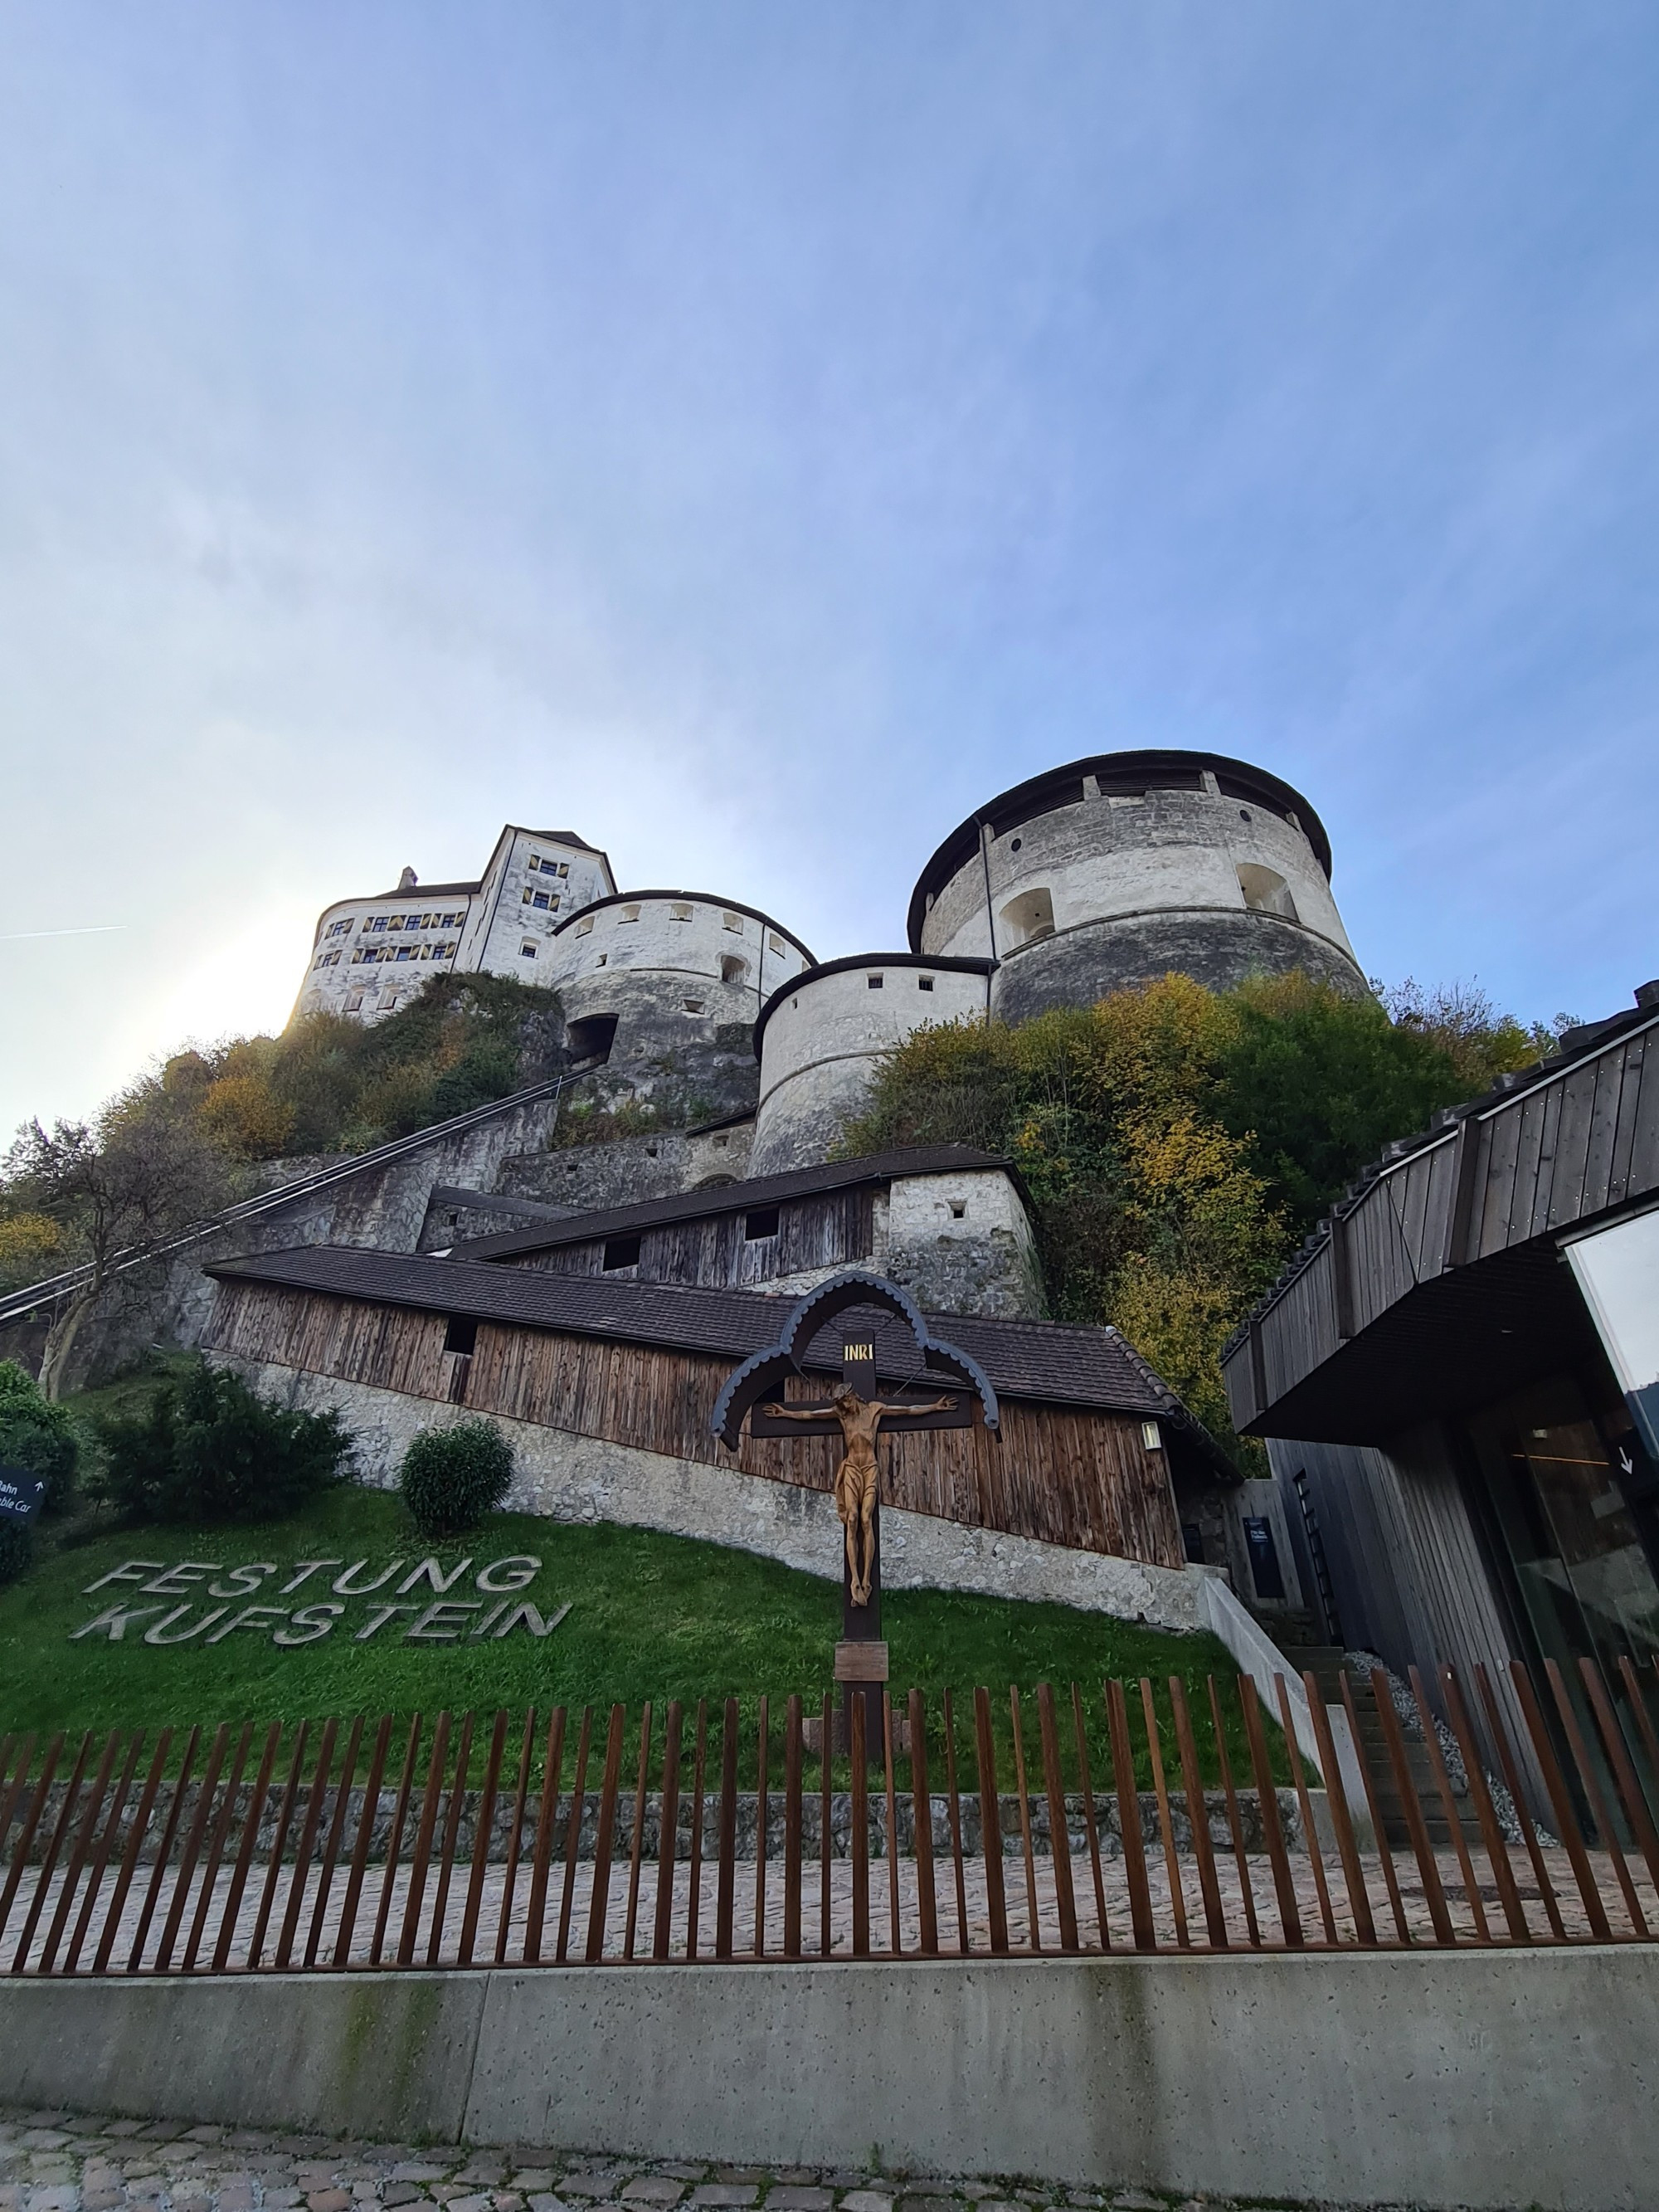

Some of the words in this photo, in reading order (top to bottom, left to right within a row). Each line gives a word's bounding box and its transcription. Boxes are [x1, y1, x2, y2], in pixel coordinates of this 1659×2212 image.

[844, 1343, 873, 1362] INRI
[15, 1500, 32, 1513] Car
[81, 1554, 543, 1598] FESTUNG
[68, 1601, 574, 1645] KUFSTEIN
